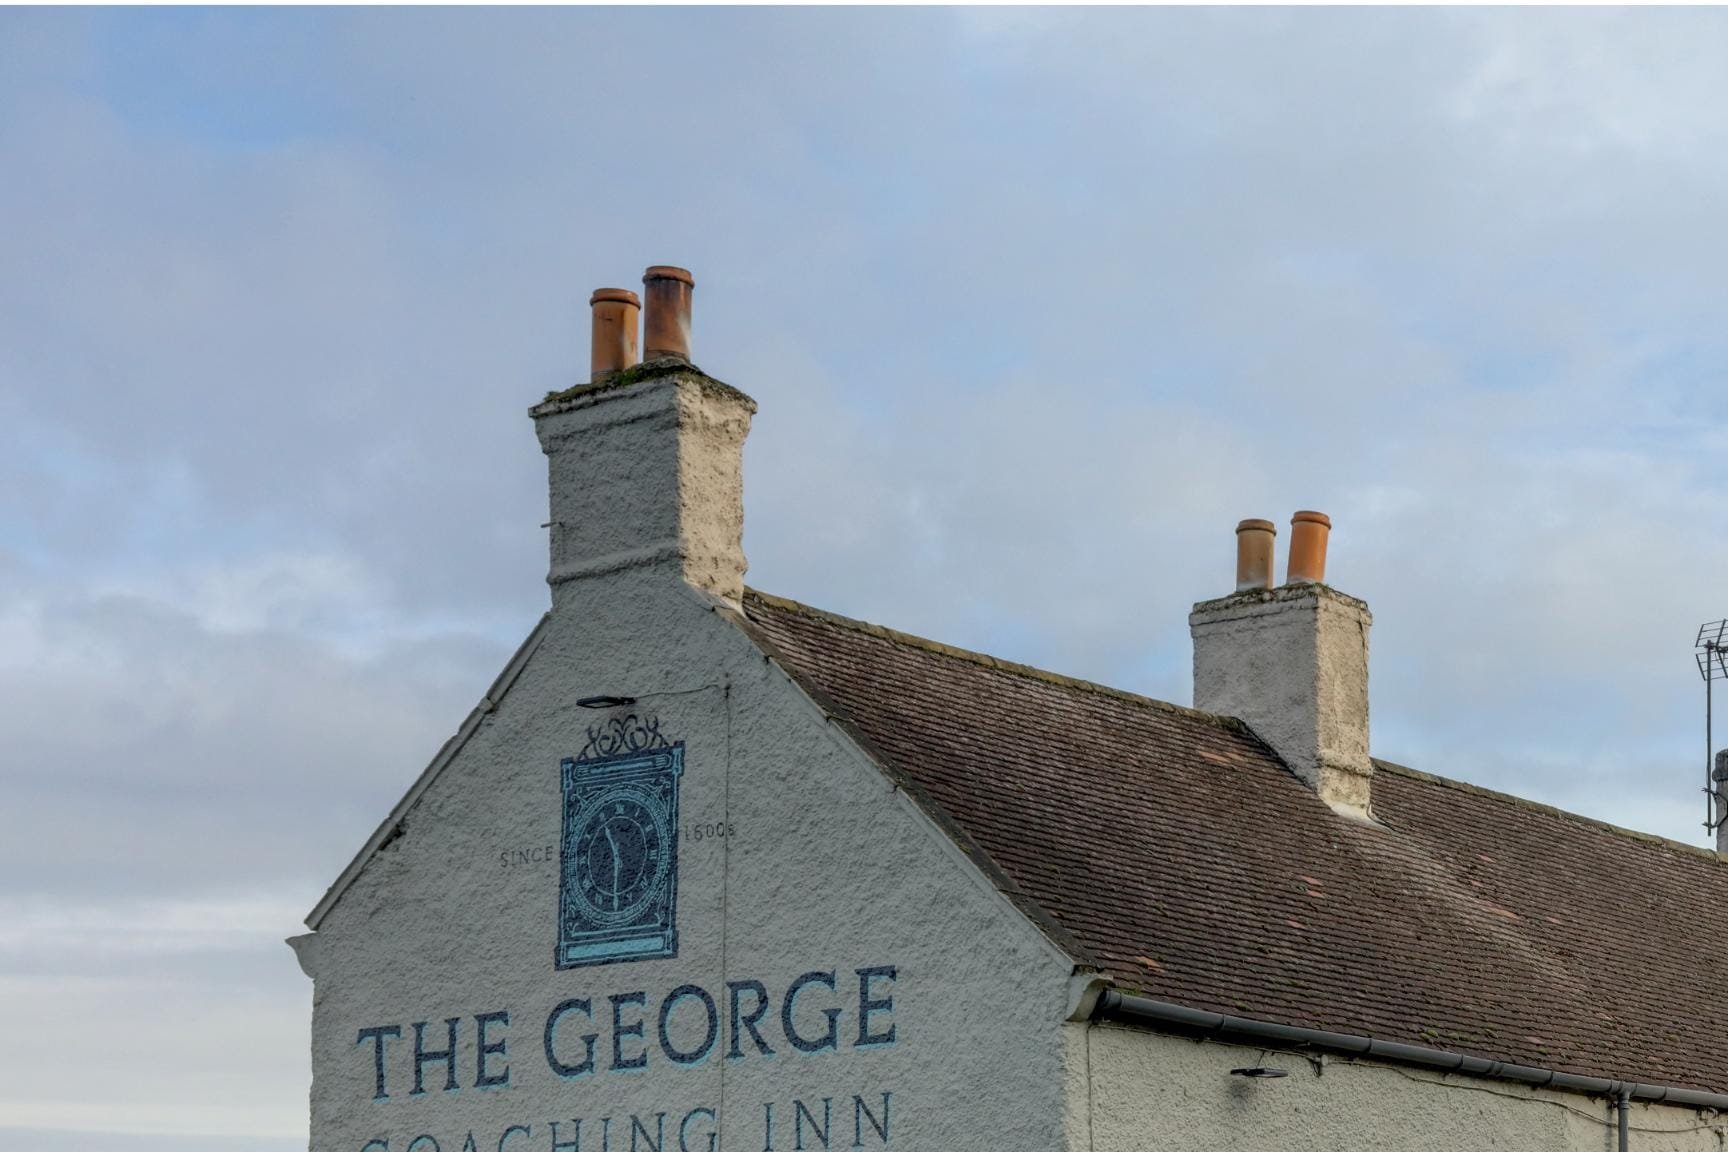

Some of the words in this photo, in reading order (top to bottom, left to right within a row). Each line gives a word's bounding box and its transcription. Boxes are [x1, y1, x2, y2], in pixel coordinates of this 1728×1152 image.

[500, 845, 554, 869] SINCE
[356, 1010, 512, 1101] THE
[543, 964, 898, 1080] GEORGE
